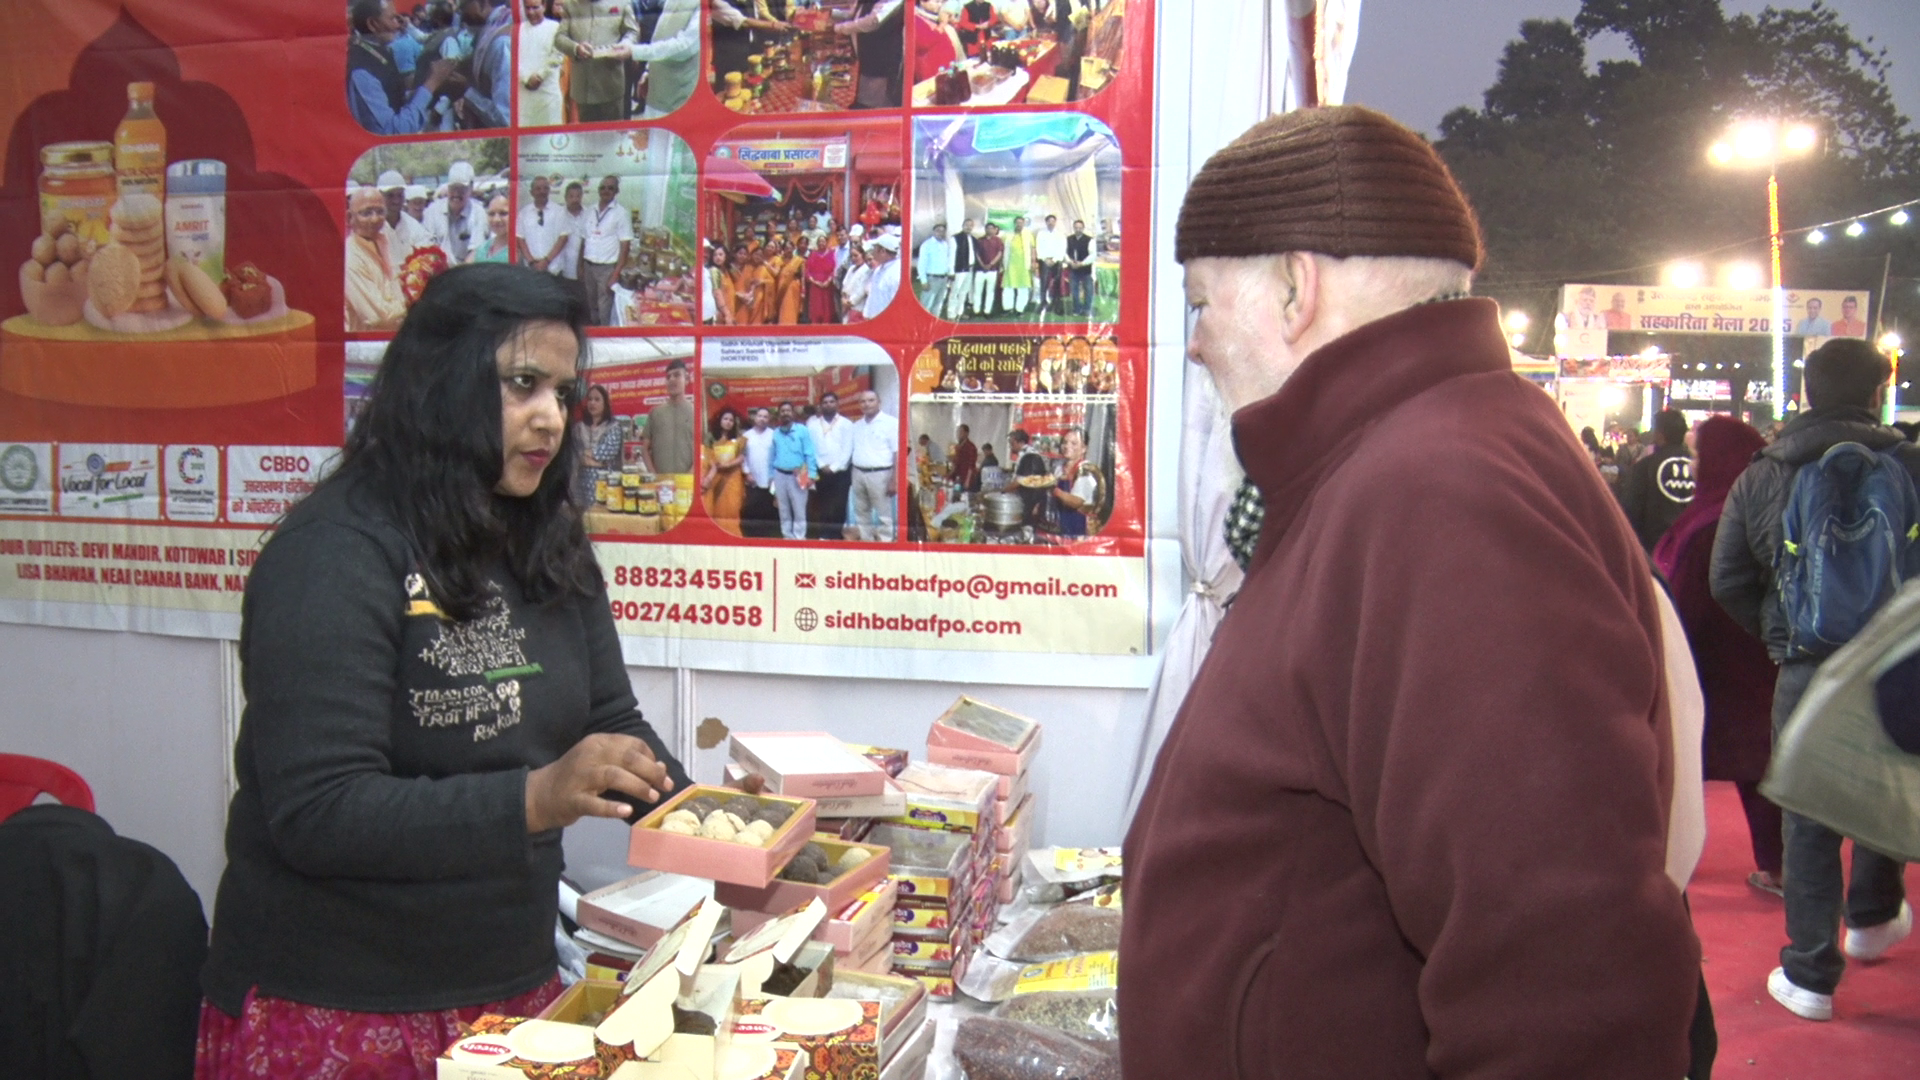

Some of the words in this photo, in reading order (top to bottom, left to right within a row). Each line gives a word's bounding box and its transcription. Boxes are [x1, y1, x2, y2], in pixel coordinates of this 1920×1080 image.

[1640, 313, 1708, 330] सहकारिता
[1713, 313, 1743, 331] मेला
[260, 456, 309, 472] CBBO
[62, 476, 92, 493] Vocal
[95, 474, 114, 495] for
[115, 472, 147, 490] Local
[27, 539, 79, 557] OUTLETS:
[82, 542, 109, 559] DEVI
[165, 546, 226, 565] KOTDWAR
[17, 563, 41, 579] LISA
[101, 567, 131, 585] NEAR
[134, 569, 182, 588] CANARA
[184, 572, 222, 593] BANK,
[614, 565, 763, 591] 8882345561
[824, 571, 1118, 599] sidhbabafpo@gmail.com
[611, 599, 762, 626] 9027443058
[824, 610, 1022, 637] sidhbabafpo.com
